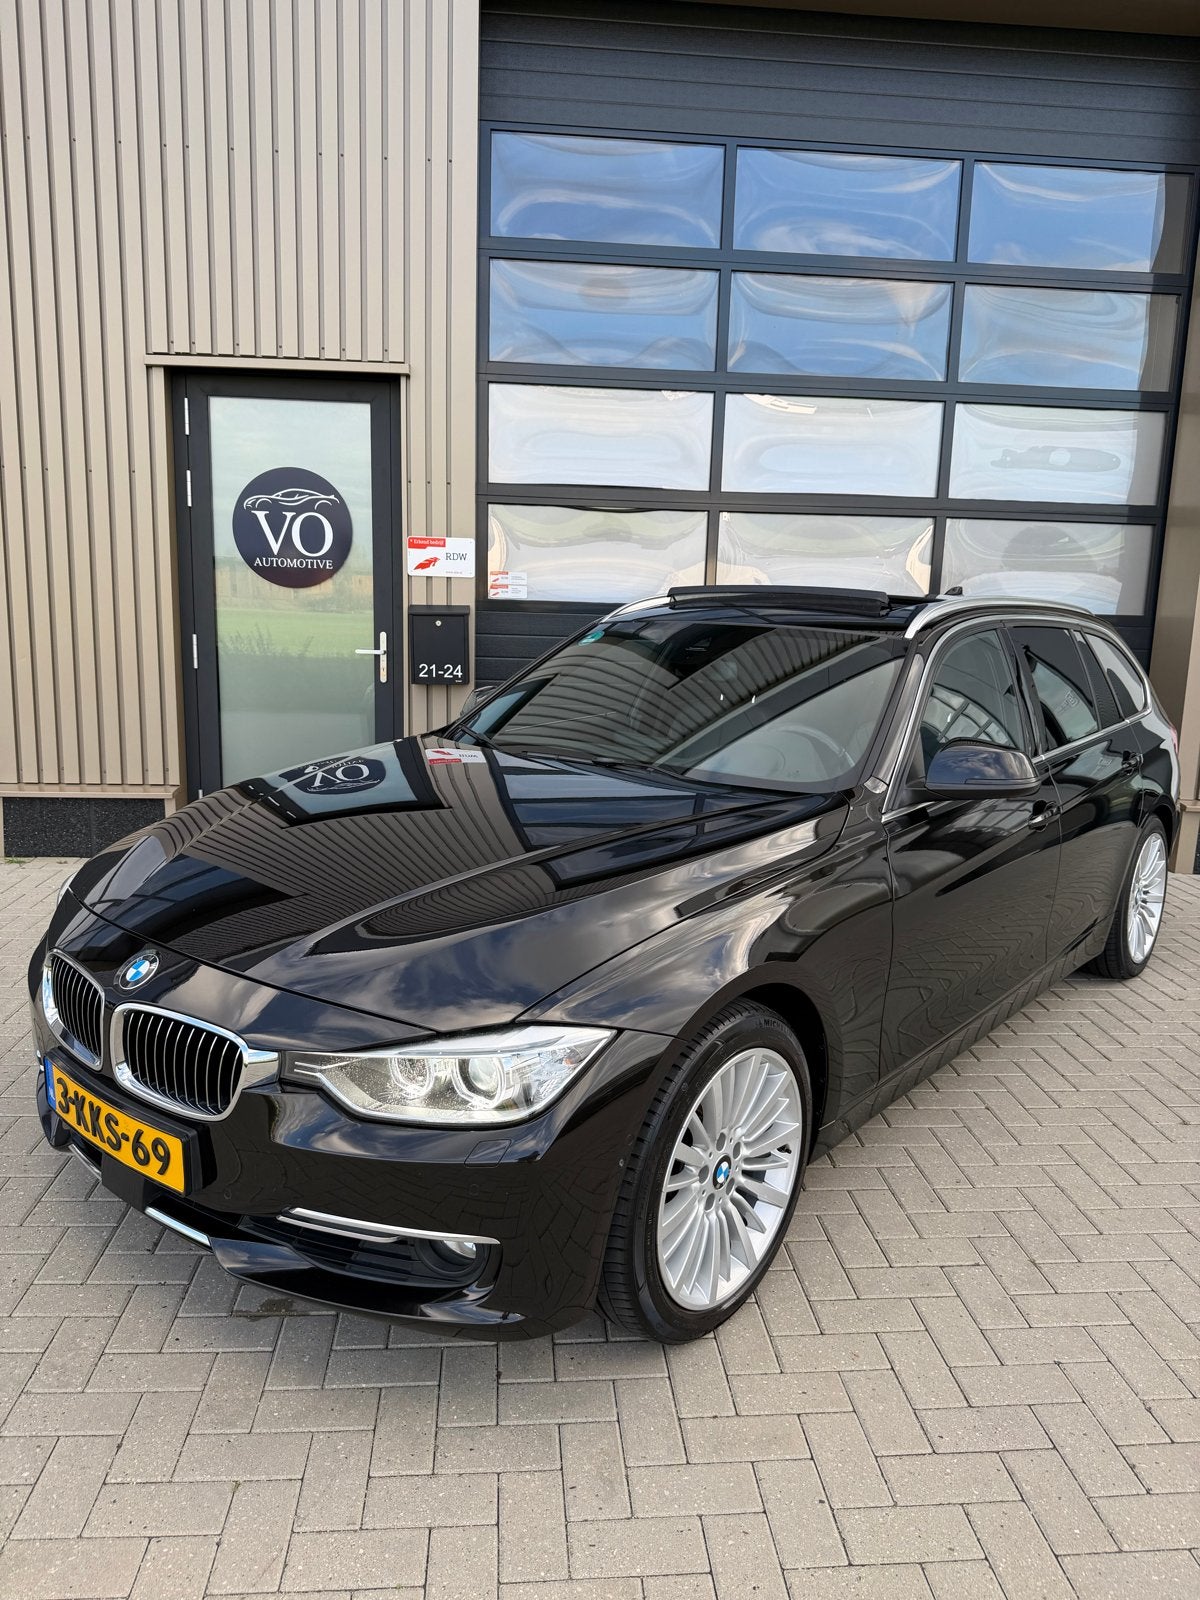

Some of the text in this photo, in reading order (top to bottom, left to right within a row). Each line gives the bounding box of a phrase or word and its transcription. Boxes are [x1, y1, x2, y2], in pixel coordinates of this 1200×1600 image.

[251, 510, 334, 558] VO
[253, 556, 334, 570] AUTOMOTIVE
[445, 552, 468, 561] RDW
[418, 663, 463, 679] 21-24
[55, 1077, 171, 1176] 3-KKS-69
